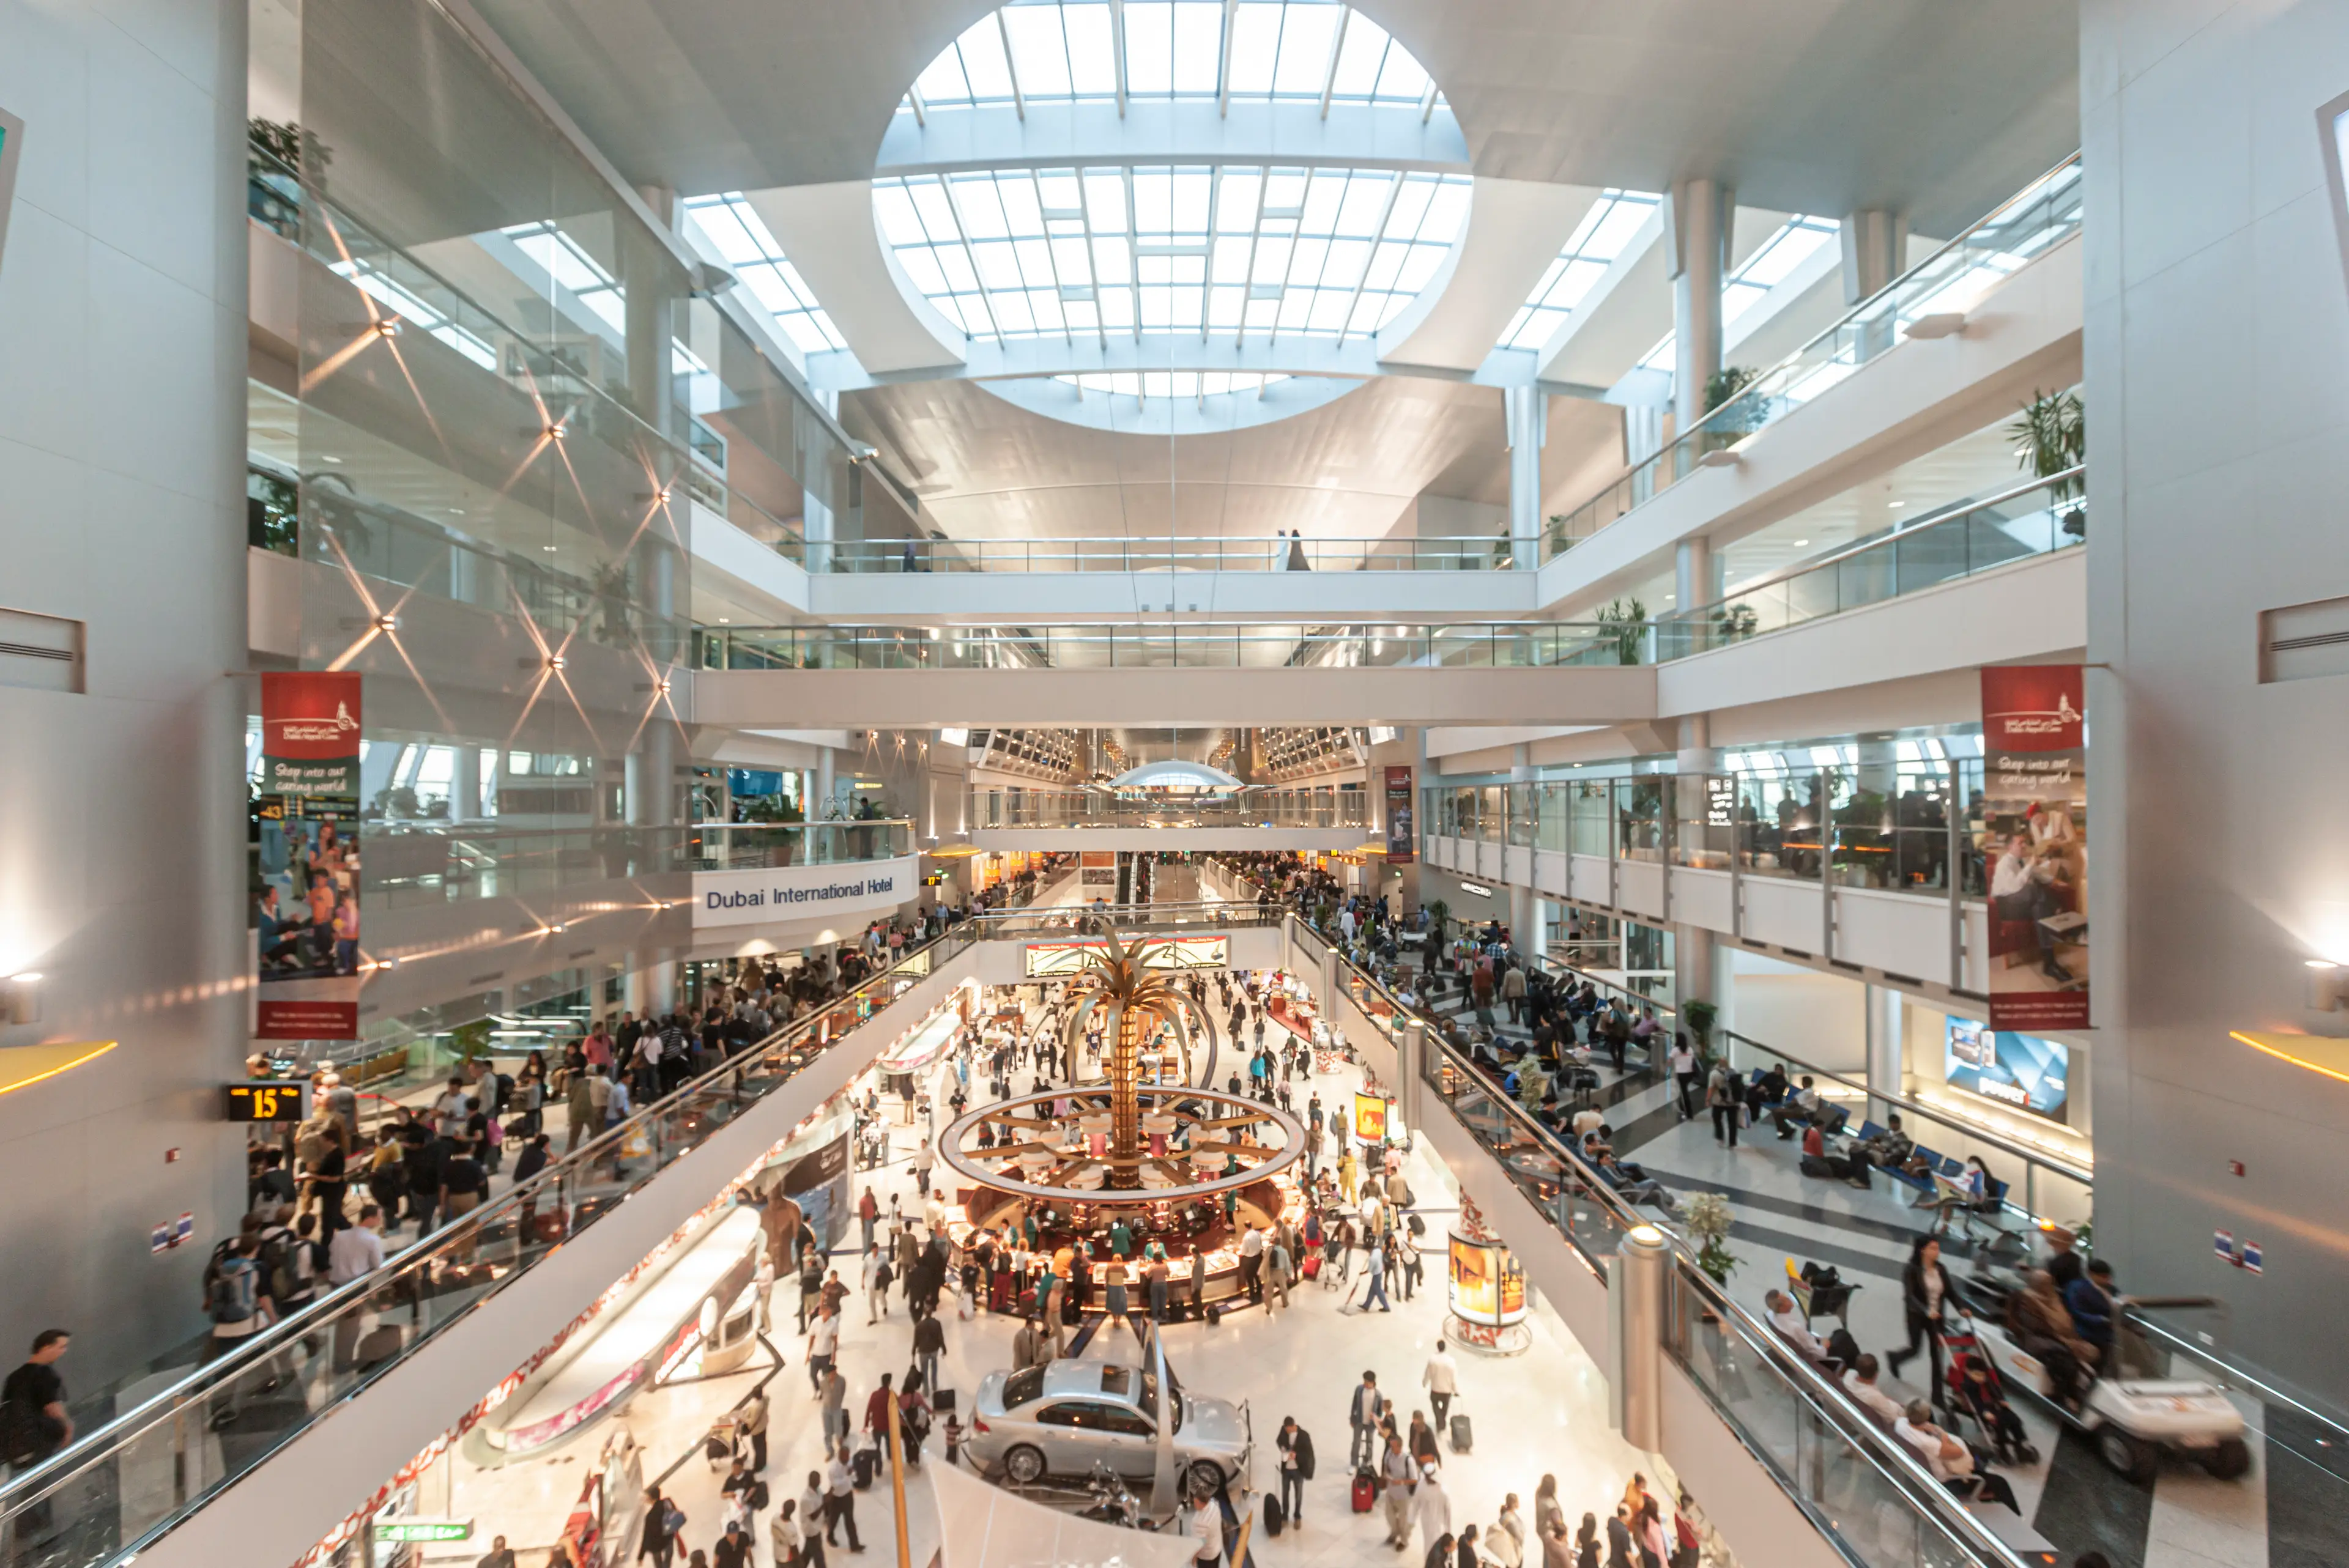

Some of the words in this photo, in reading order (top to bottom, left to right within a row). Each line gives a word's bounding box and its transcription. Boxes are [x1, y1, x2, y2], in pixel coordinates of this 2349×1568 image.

[275, 763, 302, 782] Step
[303, 767, 325, 777] into
[328, 766, 347, 777] our
[2028, 760, 2049, 770] into
[275, 781, 313, 797] caring
[314, 778, 347, 793] world
[1999, 775, 2036, 790] caring
[2040, 771, 2071, 785] world
[928, 876, 935, 886] 17
[707, 890, 765, 909] Dubai
[773, 881, 864, 904] International
[867, 877, 892, 894] Hotel
[253, 1089, 278, 1119] 15
